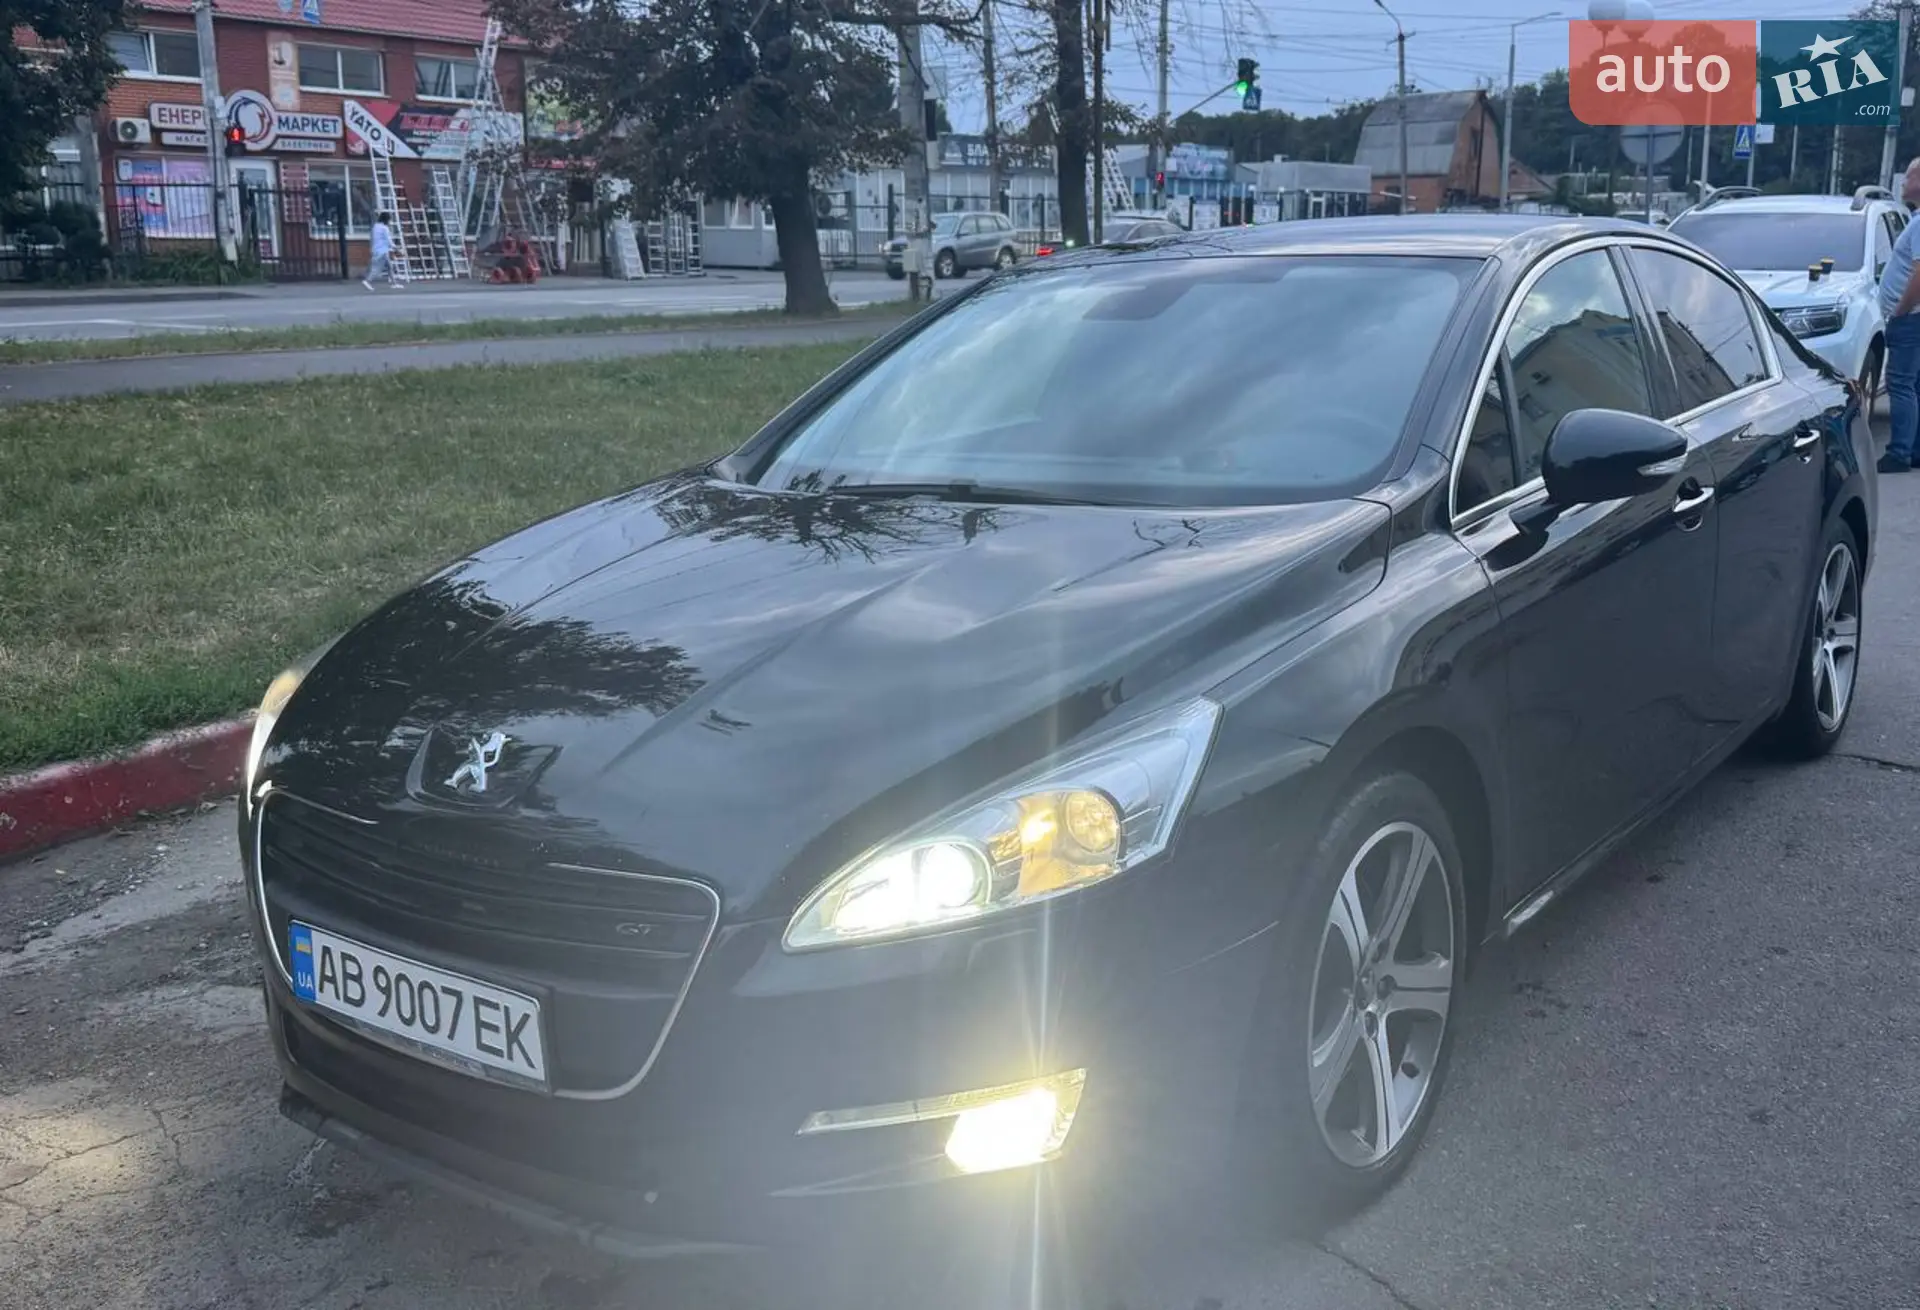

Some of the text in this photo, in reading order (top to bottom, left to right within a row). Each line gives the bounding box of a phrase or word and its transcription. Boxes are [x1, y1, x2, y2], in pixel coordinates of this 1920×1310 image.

[278, 115, 339, 133] МАРКЕТ
[349, 106, 382, 142] YATO
[298, 971, 314, 990] UA
[318, 944, 366, 1008] AB
[372, 964, 463, 1041] 9007
[472, 995, 537, 1069] EK
